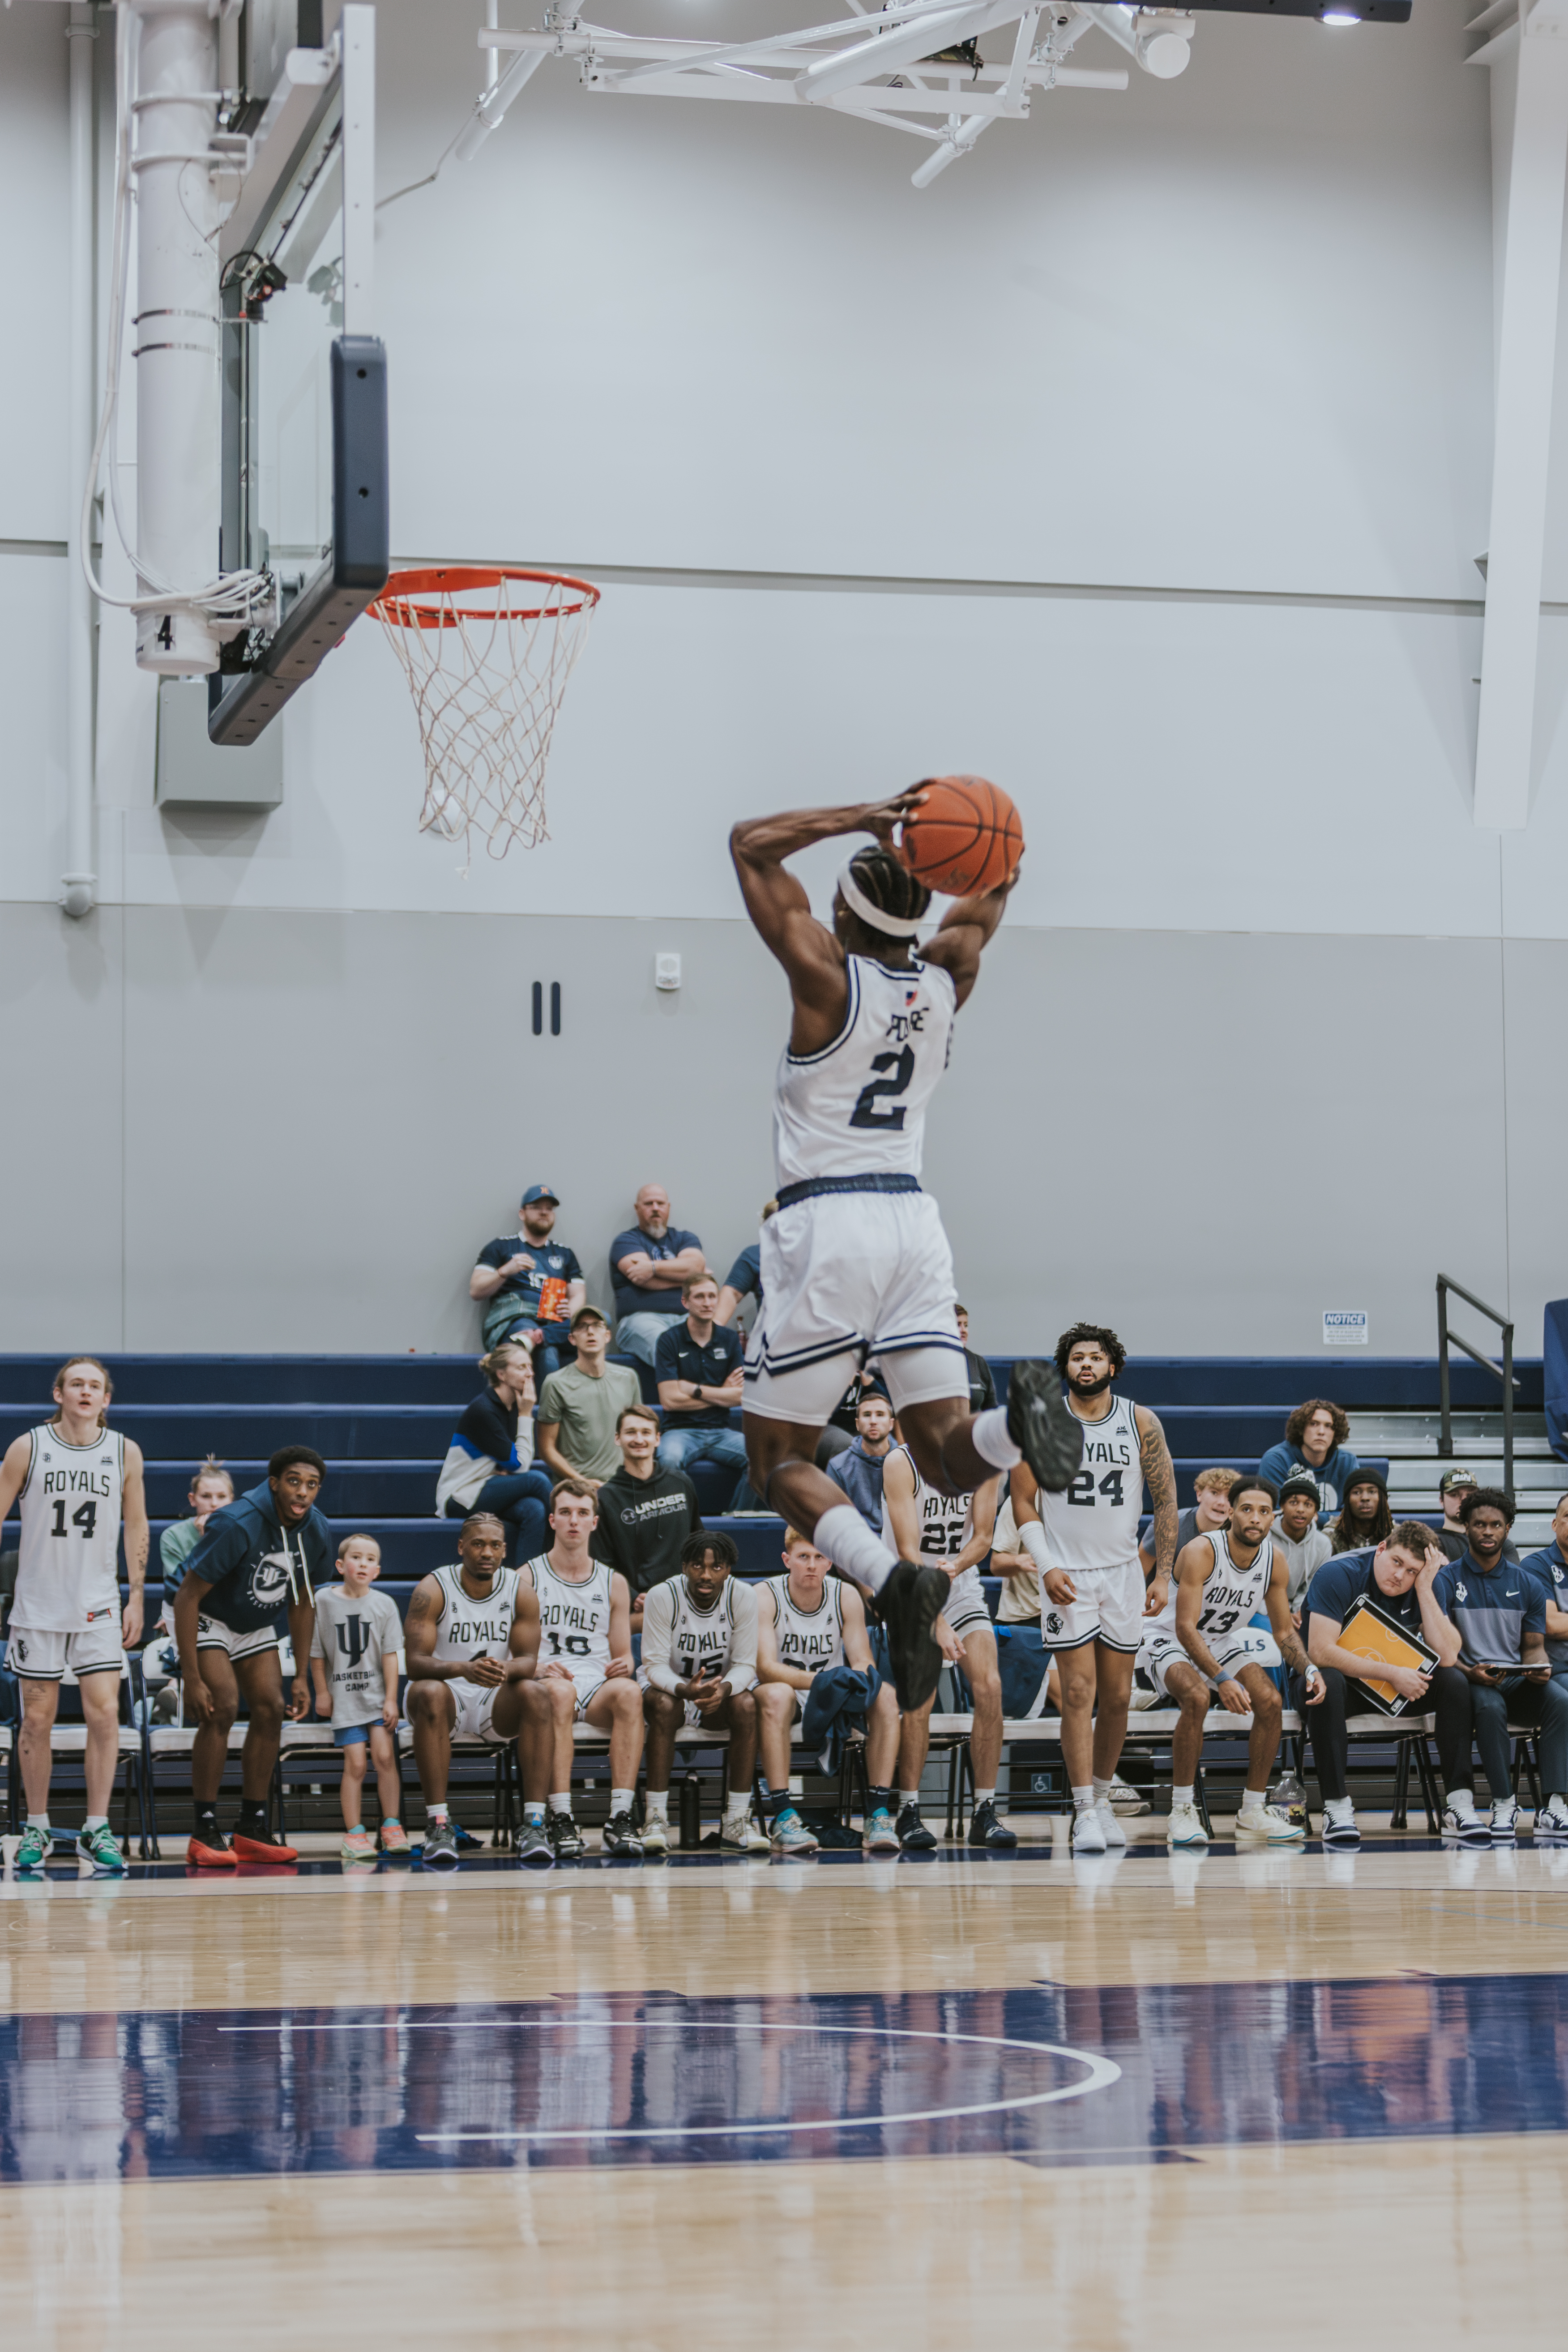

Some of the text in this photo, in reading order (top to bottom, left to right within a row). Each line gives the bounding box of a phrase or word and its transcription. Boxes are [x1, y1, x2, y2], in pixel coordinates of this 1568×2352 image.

[158, 615, 173, 650] 4
[849, 1044, 914, 1130] 2
[1326, 1315, 1364, 1324] NOTICE
[1085, 1443, 1130, 1466] YALS
[44, 1470, 110, 1497] ROYALS
[1068, 1470, 1124, 1507] 24
[635, 1493, 686, 1514] UNDER
[640, 1503, 687, 1521] ARMOUR
[51, 1500, 97, 1538] 14
[919, 1521, 965, 1555] 22
[1205, 1587, 1255, 1608] ROYALS
[540, 1605, 598, 1632] ROYALS
[1196, 1609, 1239, 1634] 13
[449, 1621, 507, 1643] ROYALS
[548, 1632, 591, 1656] 10
[781, 1634, 833, 1654] ROYALS
[680, 1653, 723, 1679] 15
[346, 1682, 369, 1691] CAMP
